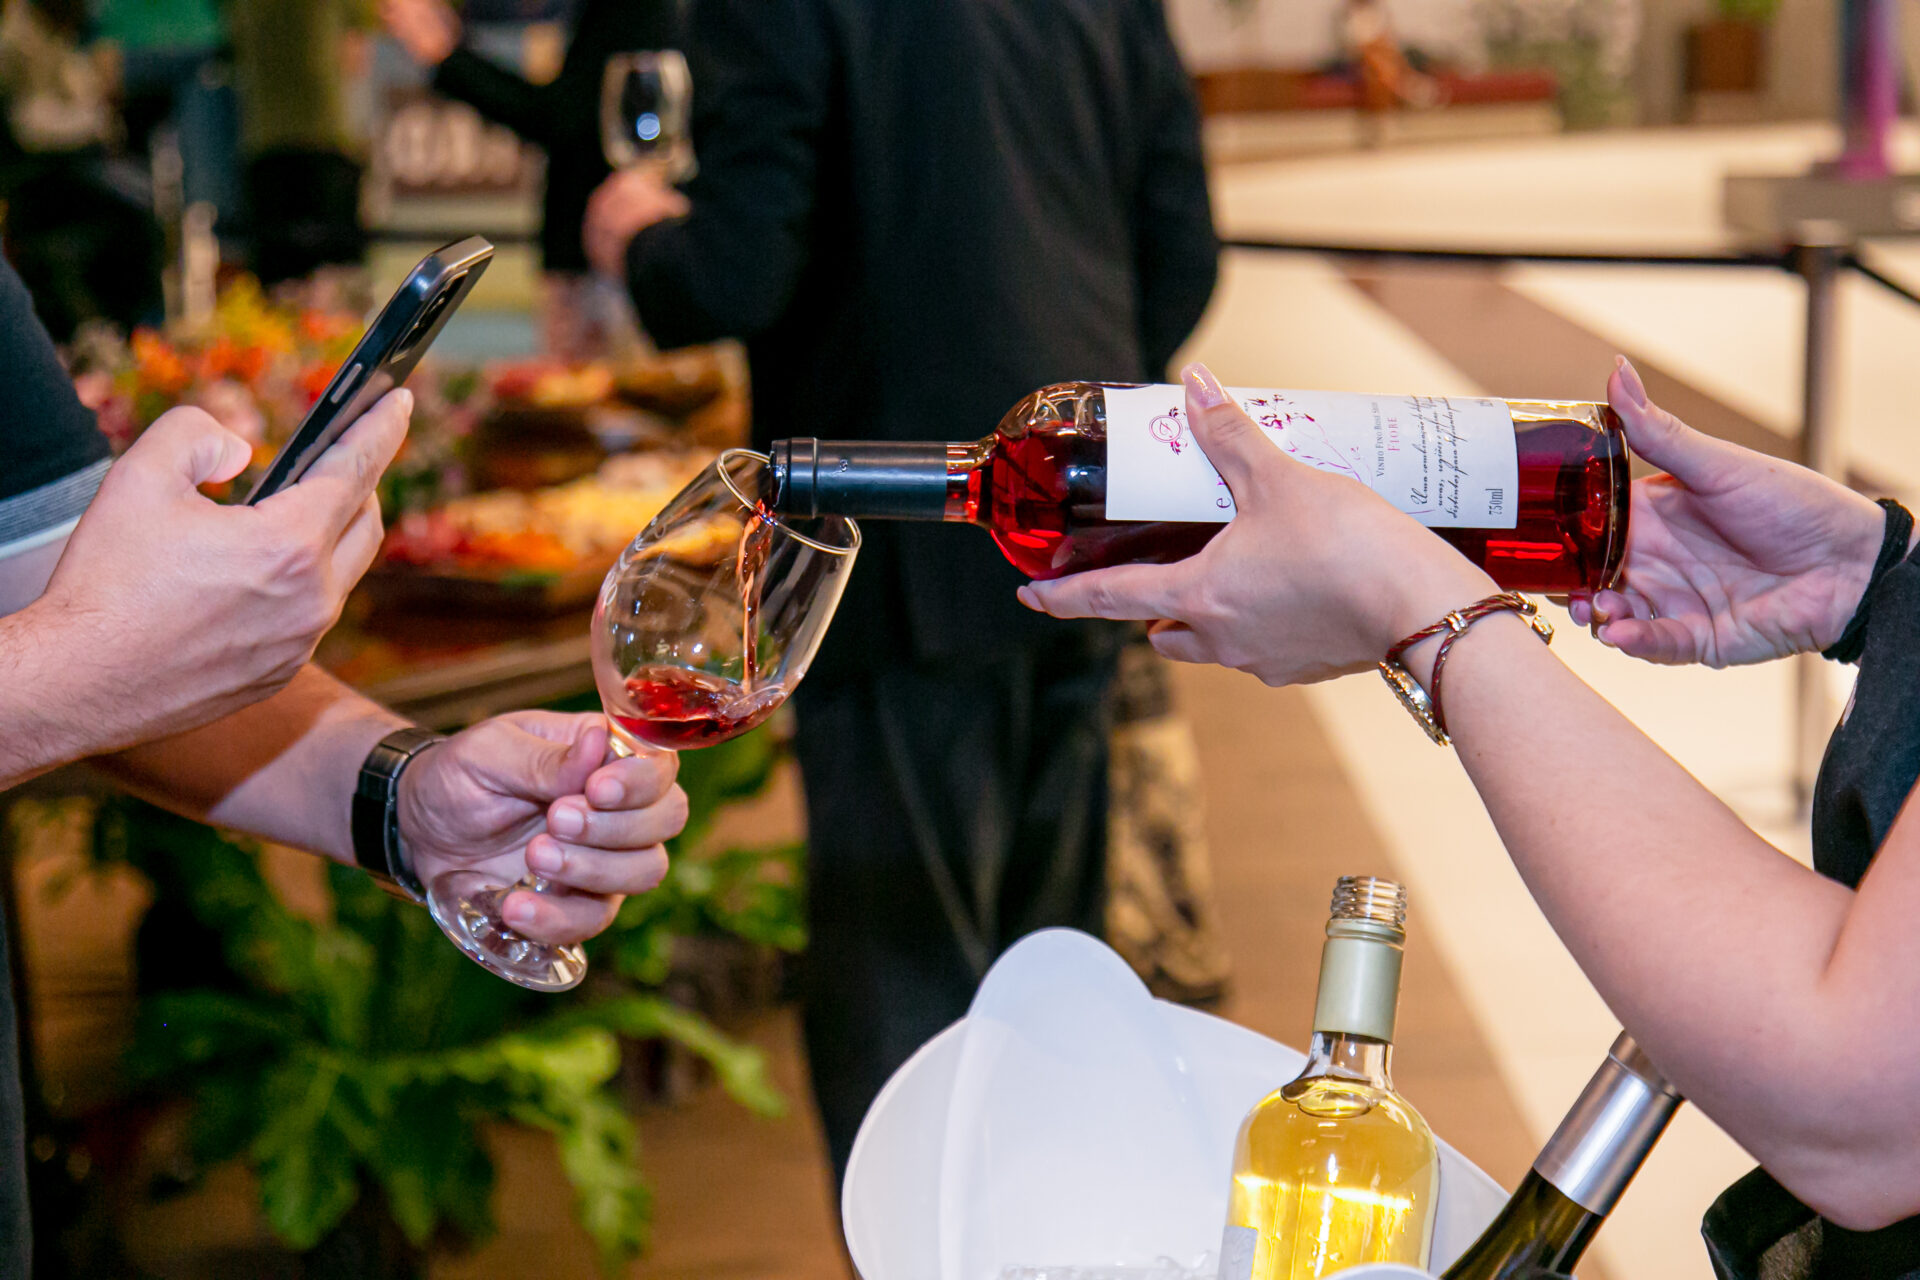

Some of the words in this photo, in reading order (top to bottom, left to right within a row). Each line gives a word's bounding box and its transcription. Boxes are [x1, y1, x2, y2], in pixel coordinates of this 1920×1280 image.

[1375, 431, 1384, 449] FINO
[1387, 417, 1400, 451] FIORE
[1411, 421, 1428, 473] combinação
[1376, 451, 1385, 477] VINHO
[1410, 476, 1428, 504] Uma
[1444, 475, 1459, 518] distintos
[1453, 449, 1469, 475] para
[1485, 488, 1503, 515] 750ml
